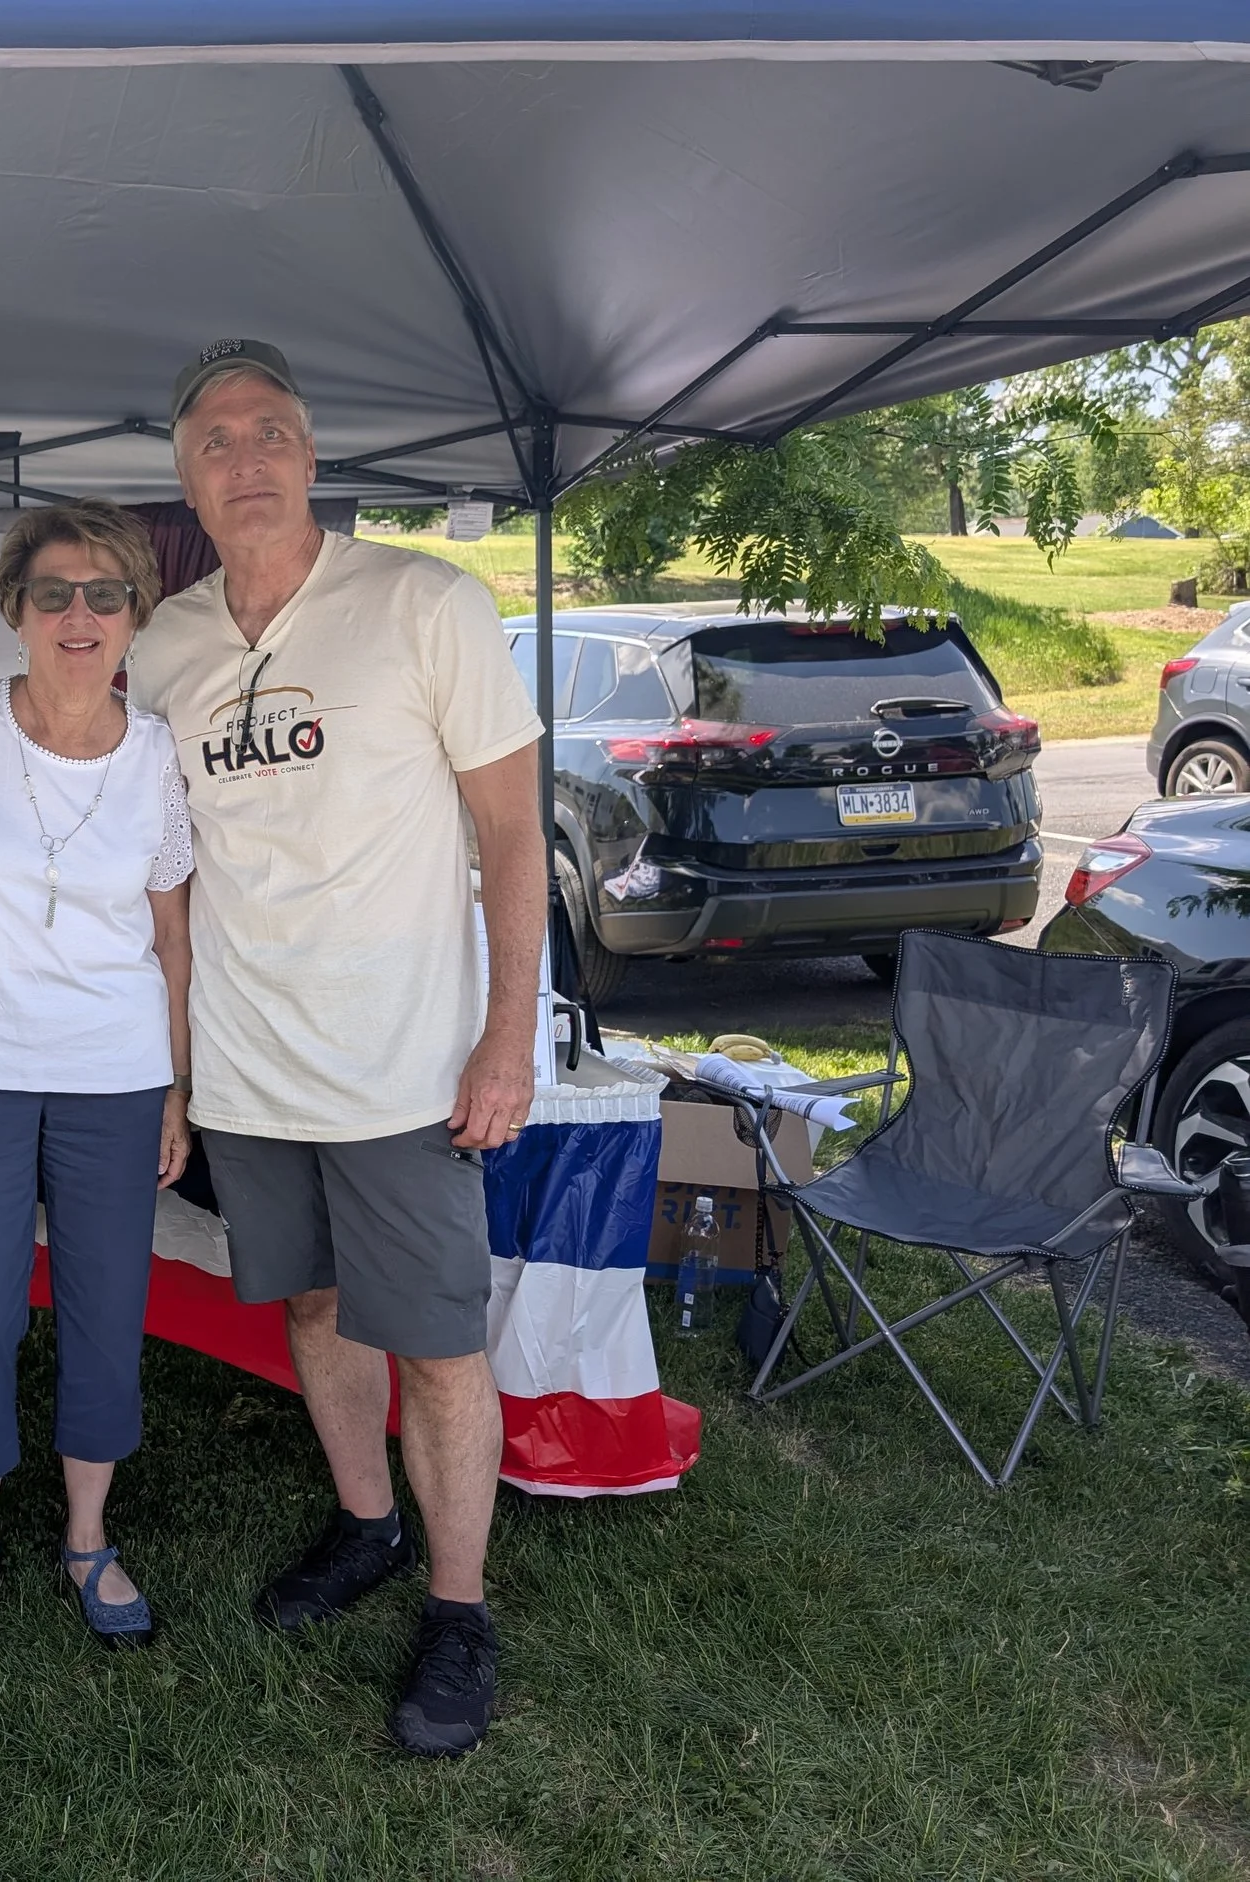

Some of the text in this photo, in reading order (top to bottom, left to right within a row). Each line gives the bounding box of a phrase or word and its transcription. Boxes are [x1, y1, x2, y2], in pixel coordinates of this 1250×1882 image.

[226, 707, 298, 733] PROJECT
[202, 718, 324, 776] HALO
[218, 763, 315, 784] CELEBRATE VOTE CONNECT
[832, 763, 938, 777] ROGUE
[968, 808, 989, 816] AWD
